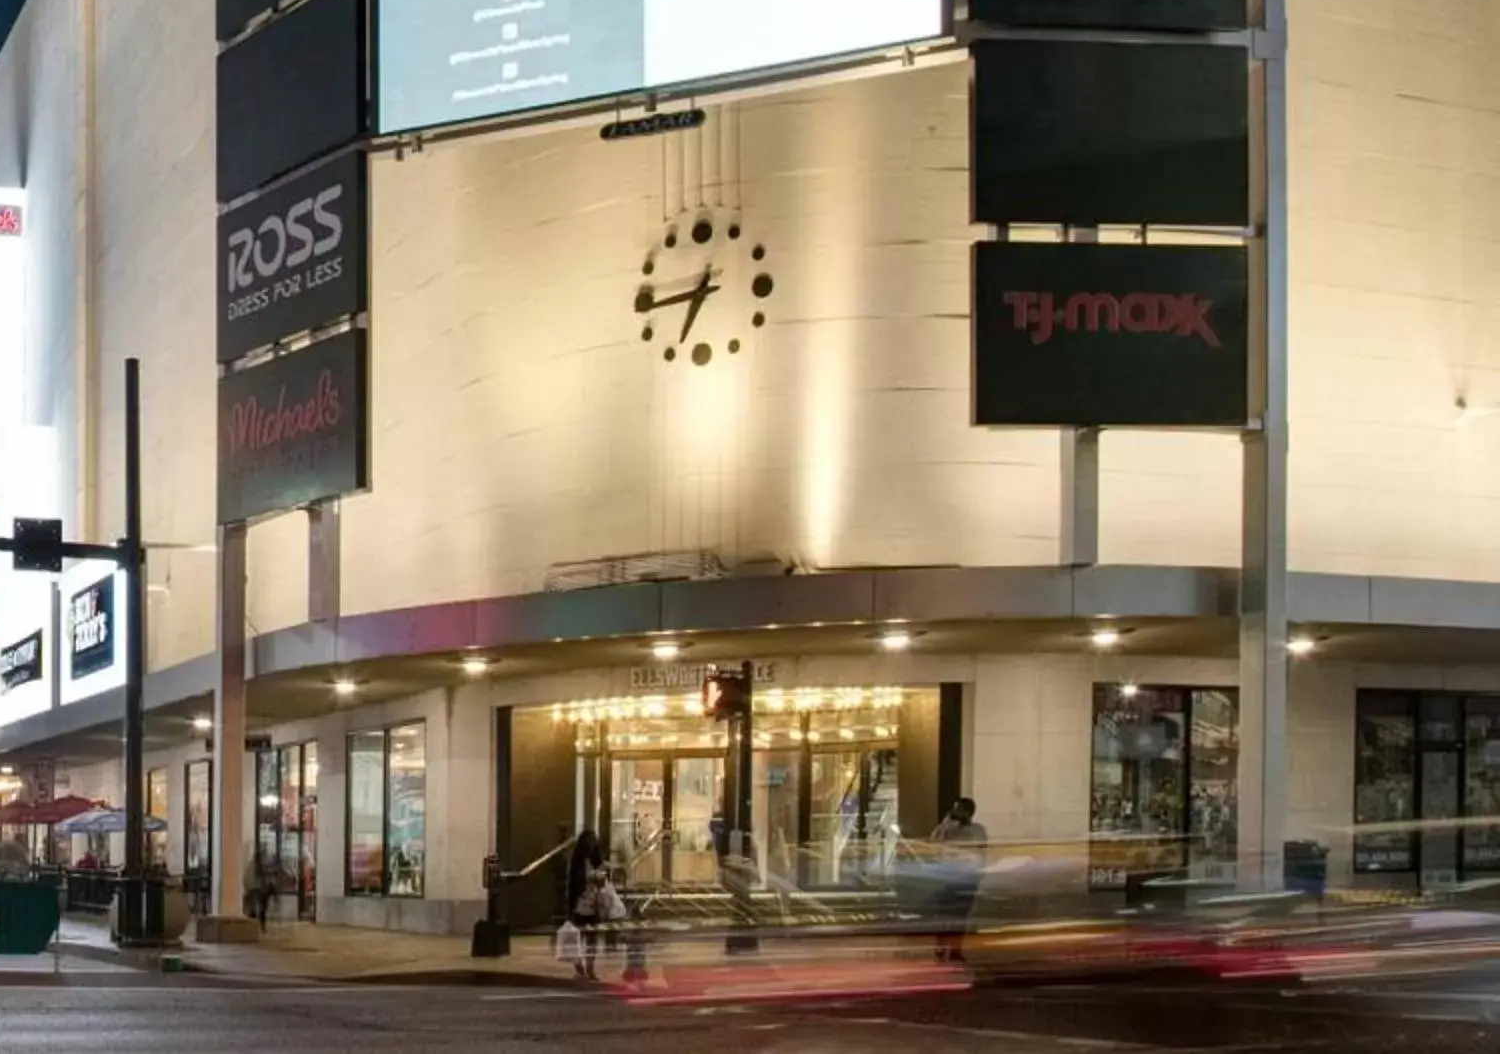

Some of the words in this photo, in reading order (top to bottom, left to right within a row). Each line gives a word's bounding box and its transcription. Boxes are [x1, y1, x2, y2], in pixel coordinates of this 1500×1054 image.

[228, 184, 343, 293] ROSS
[228, 289, 269, 321] DRESS
[273, 274, 301, 302] FOR
[307, 257, 343, 288] LESS
